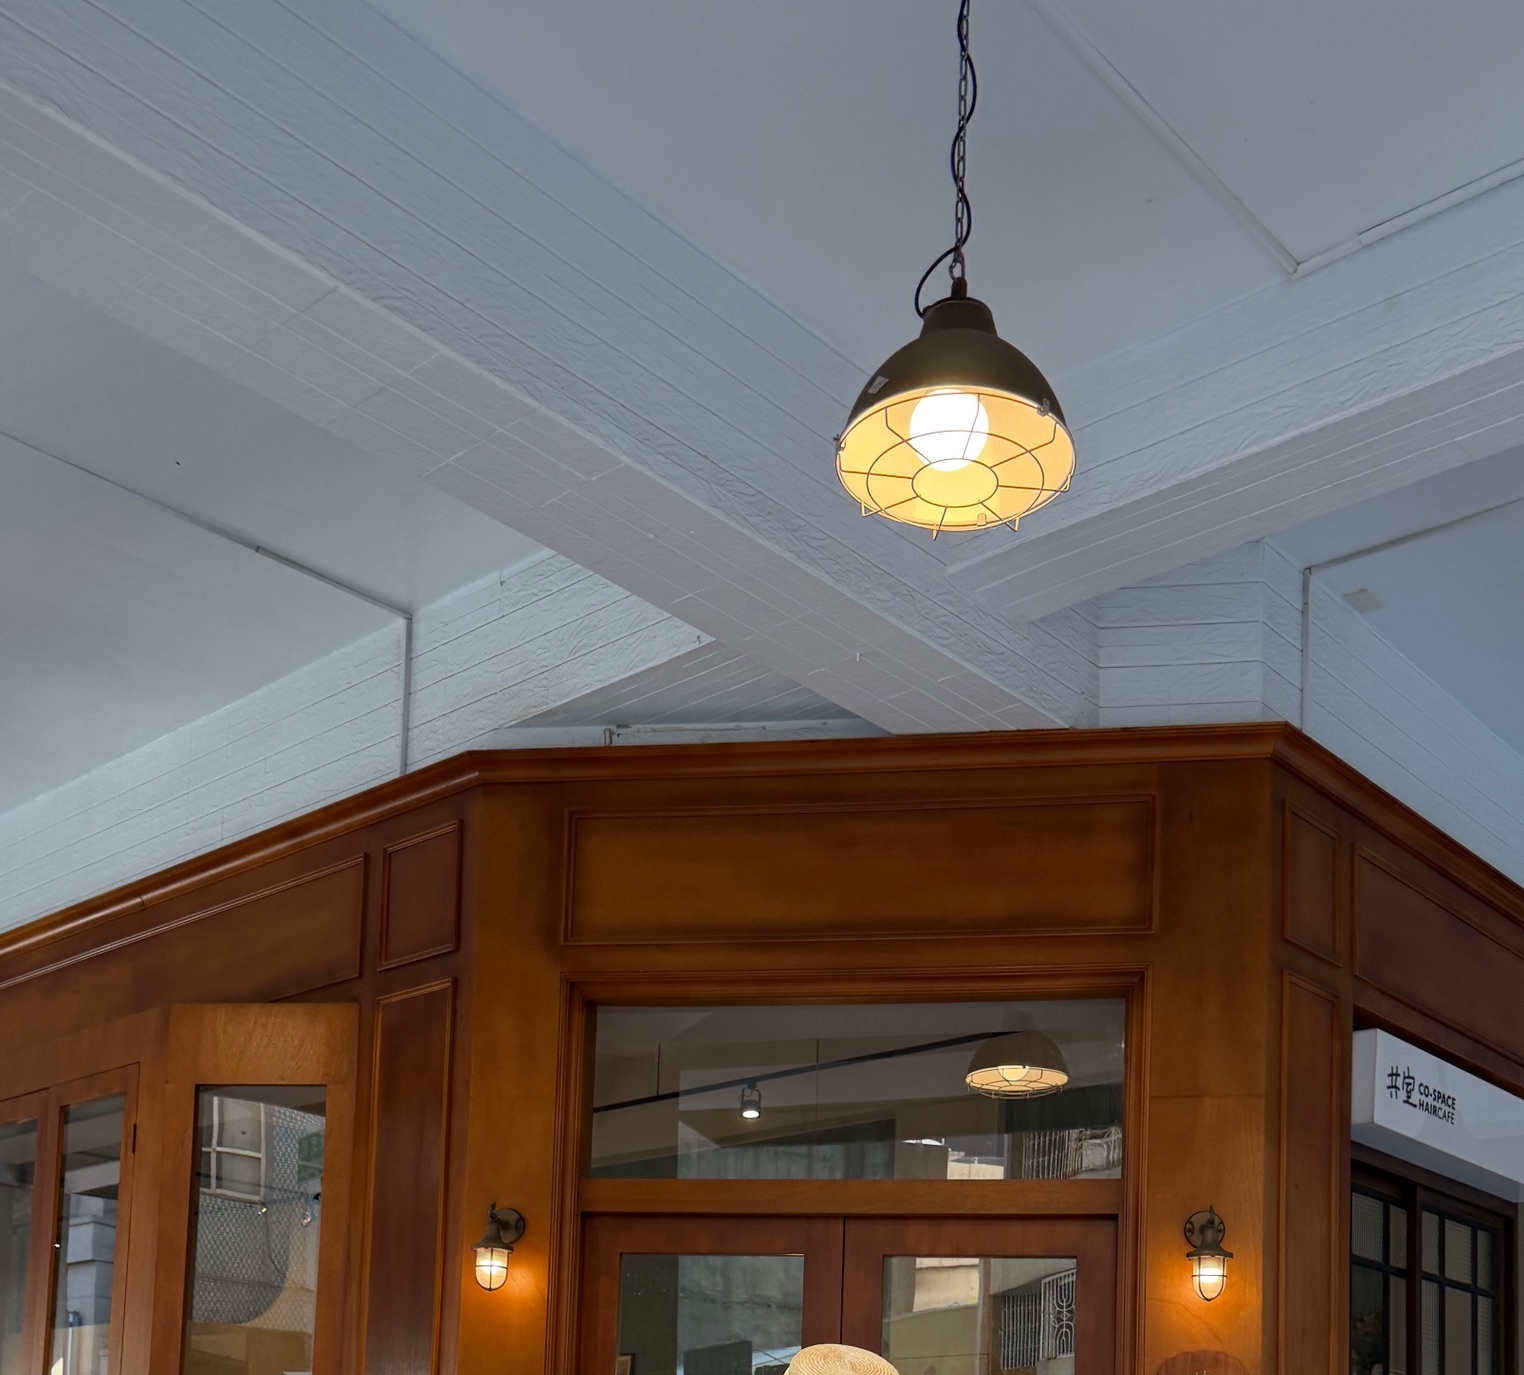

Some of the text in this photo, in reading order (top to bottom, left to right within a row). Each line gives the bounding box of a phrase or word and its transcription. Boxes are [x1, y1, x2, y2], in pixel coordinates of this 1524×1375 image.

[1386, 1065, 1417, 1109] 共室
[1418, 1082, 1456, 1111] CO-SPACE
[1418, 1098, 1455, 1125] HAIRCAFE
